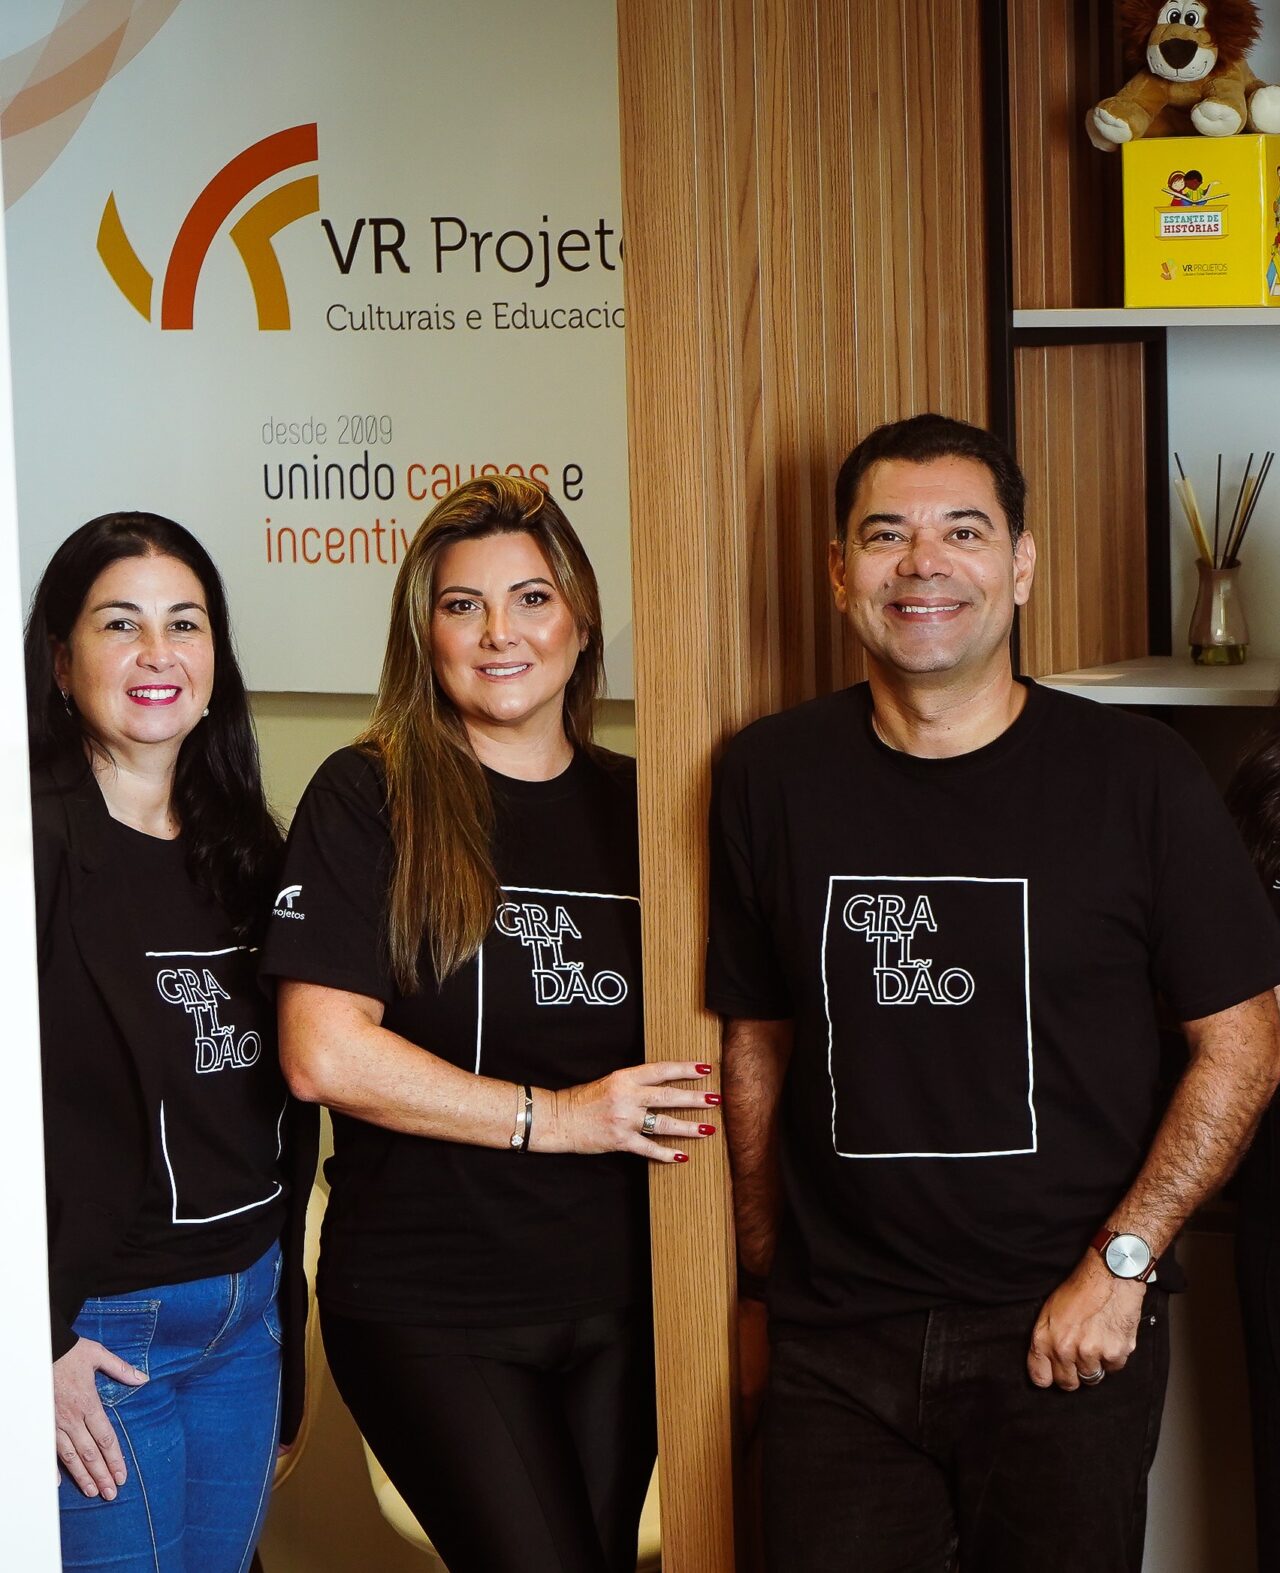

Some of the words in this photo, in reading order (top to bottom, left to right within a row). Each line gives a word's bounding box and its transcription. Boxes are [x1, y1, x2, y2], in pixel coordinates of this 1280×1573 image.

[1163, 215, 1205, 224] ESTANTE
[1207, 215, 1219, 223] DE
[1163, 221, 1219, 234] HISTÓRIAS
[321, 217, 410, 274] VR
[430, 214, 623, 288] Projet
[1182, 264, 1193, 272] VR
[326, 303, 456, 332] Culturais
[465, 308, 482, 330] e
[261, 415, 327, 445] desde
[336, 414, 393, 445] 2009
[263, 450, 395, 500] unindo
[562, 462, 584, 501] e
[495, 902, 582, 939] GRA
[843, 894, 937, 932] GRA
[157, 968, 231, 1004] GRA
[532, 962, 628, 1005] DÃO
[873, 959, 975, 1005] DÃO
[195, 1025, 261, 1073] DÃO
